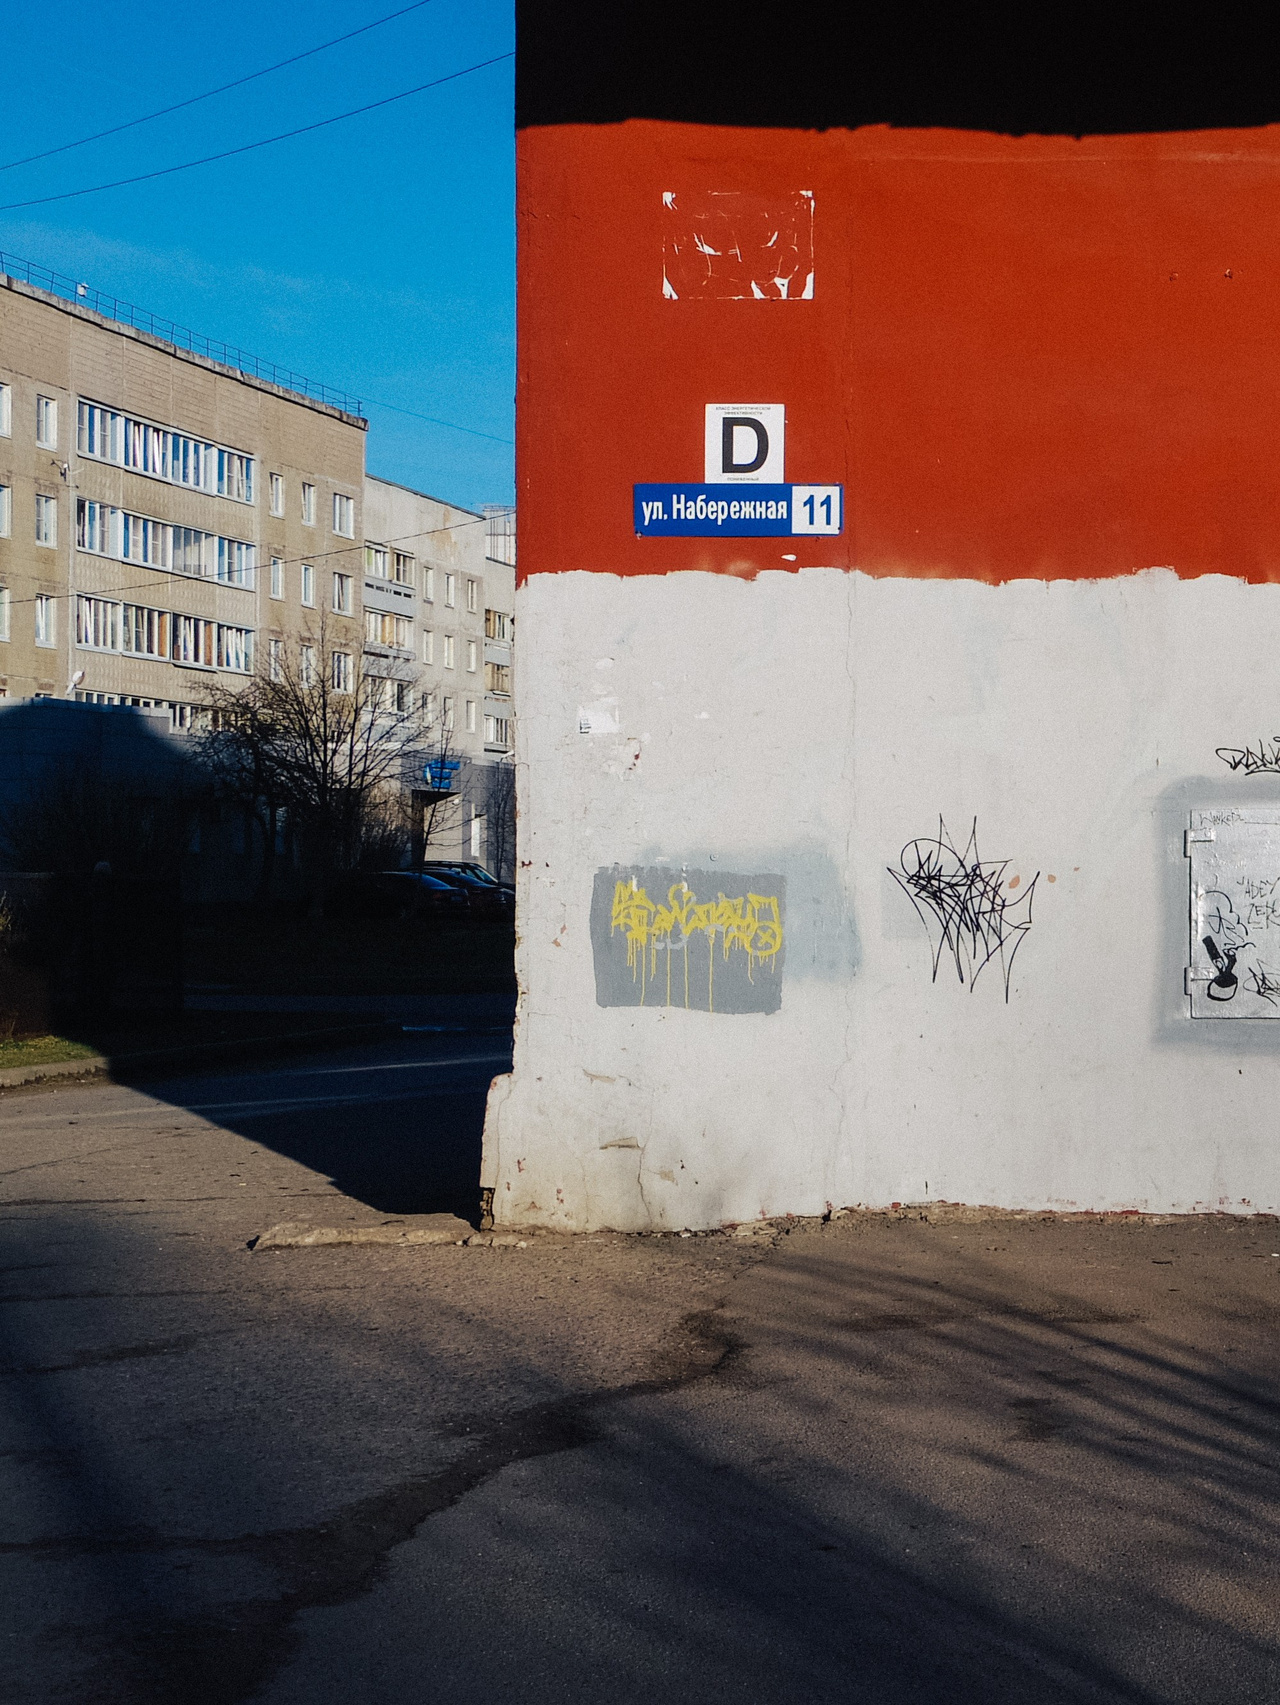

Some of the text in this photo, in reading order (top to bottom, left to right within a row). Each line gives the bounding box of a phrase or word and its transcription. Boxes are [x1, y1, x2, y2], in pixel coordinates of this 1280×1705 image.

[722, 417, 769, 473] D
[642, 494, 832, 526] ул. Набережная 11
